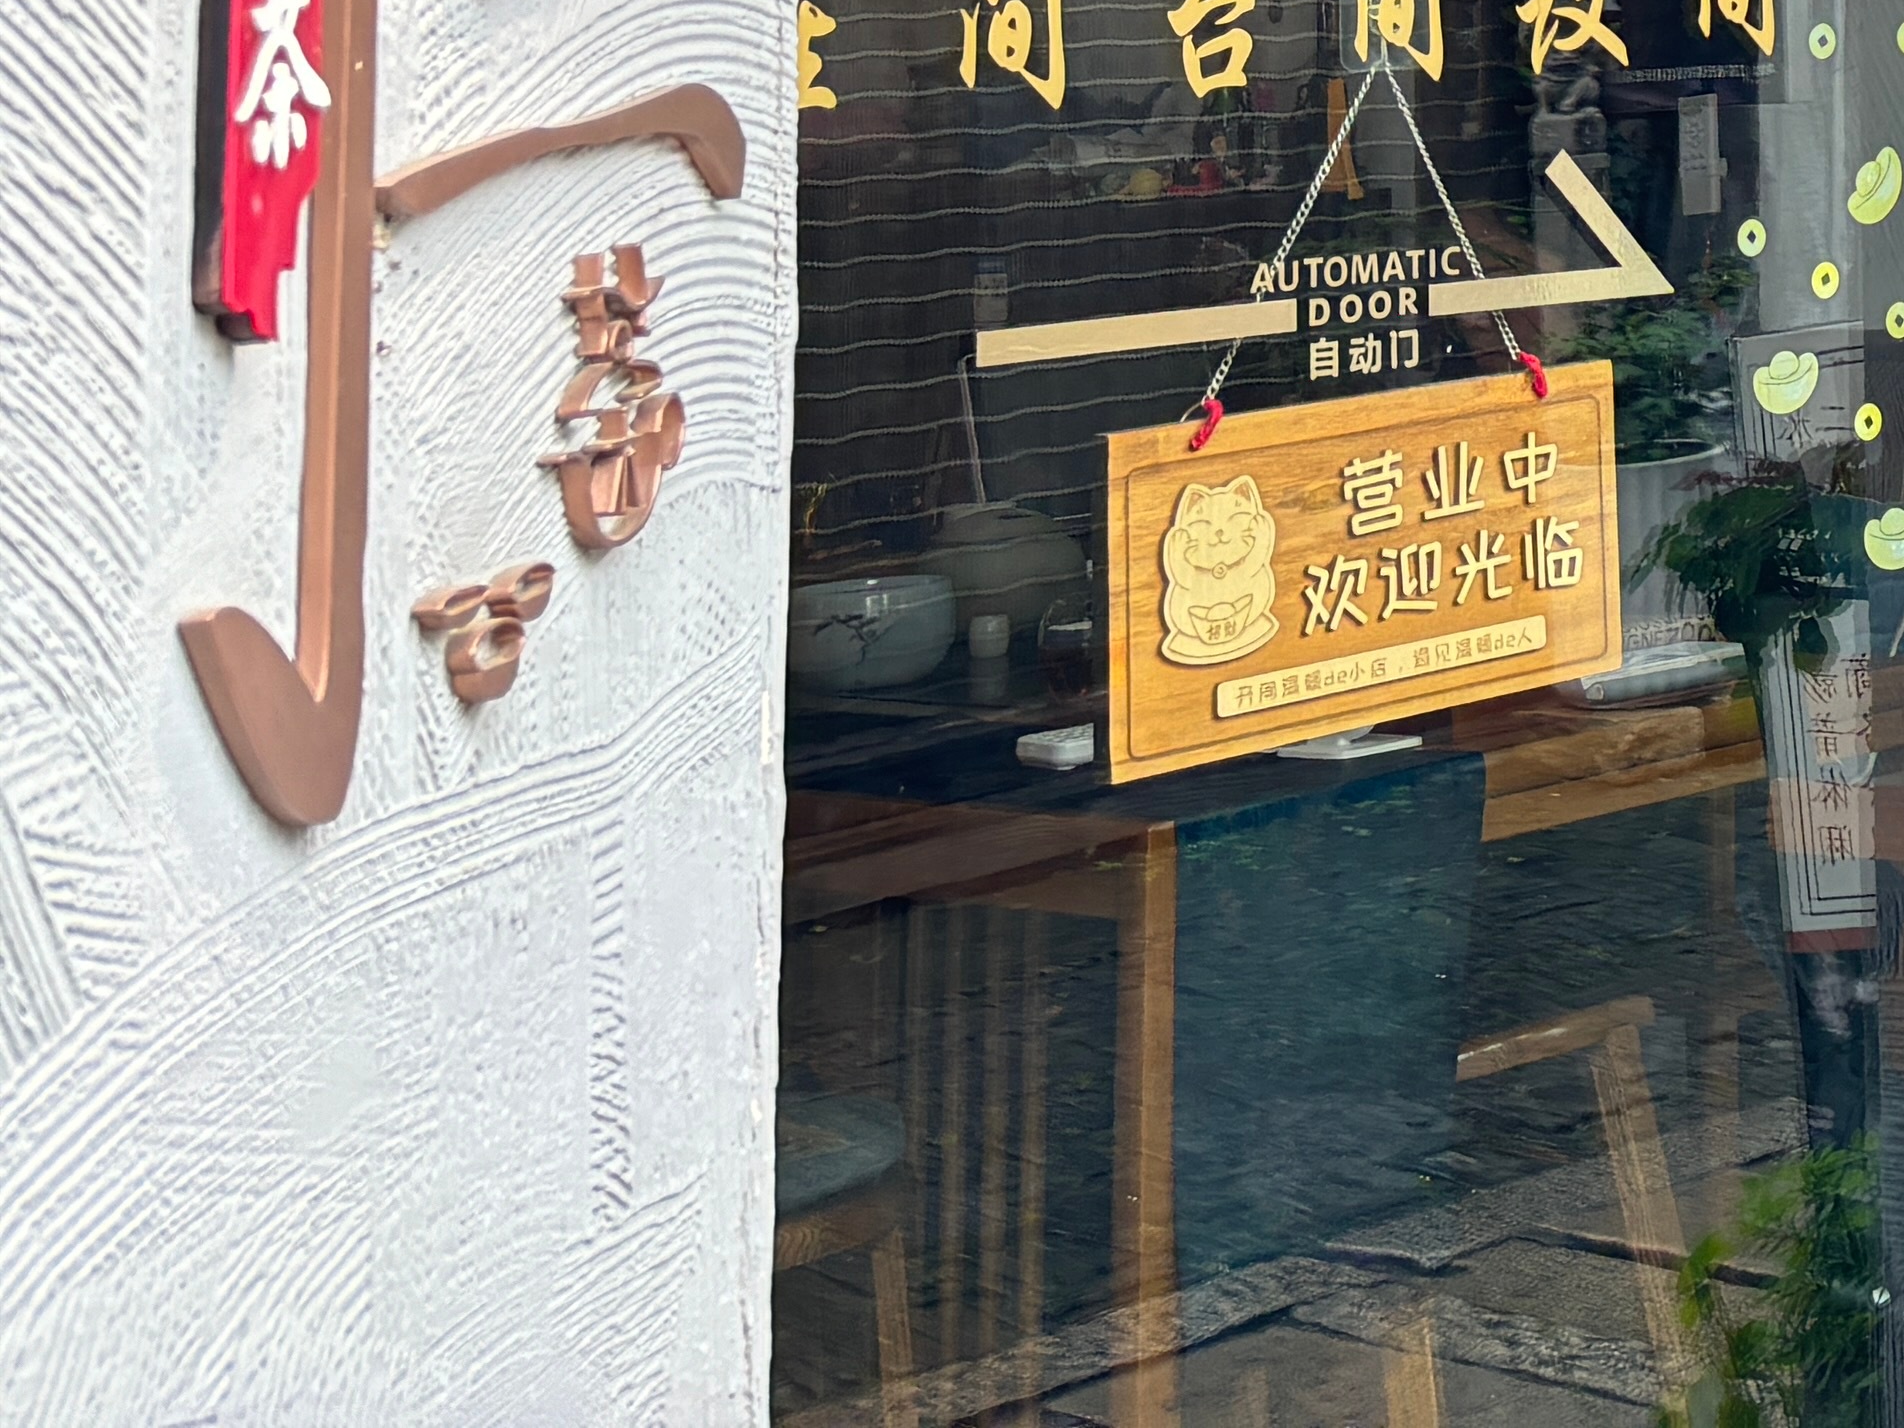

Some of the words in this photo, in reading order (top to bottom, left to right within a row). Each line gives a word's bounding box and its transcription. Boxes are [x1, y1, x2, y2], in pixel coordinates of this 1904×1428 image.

[1250, 244, 1462, 291] AUTOMATIC
[1308, 288, 1419, 327] DOOR
[1308, 329, 1420, 381] 自动门
[1343, 431, 1558, 538] 营业中
[1302, 515, 1585, 636] 欢迎光临
